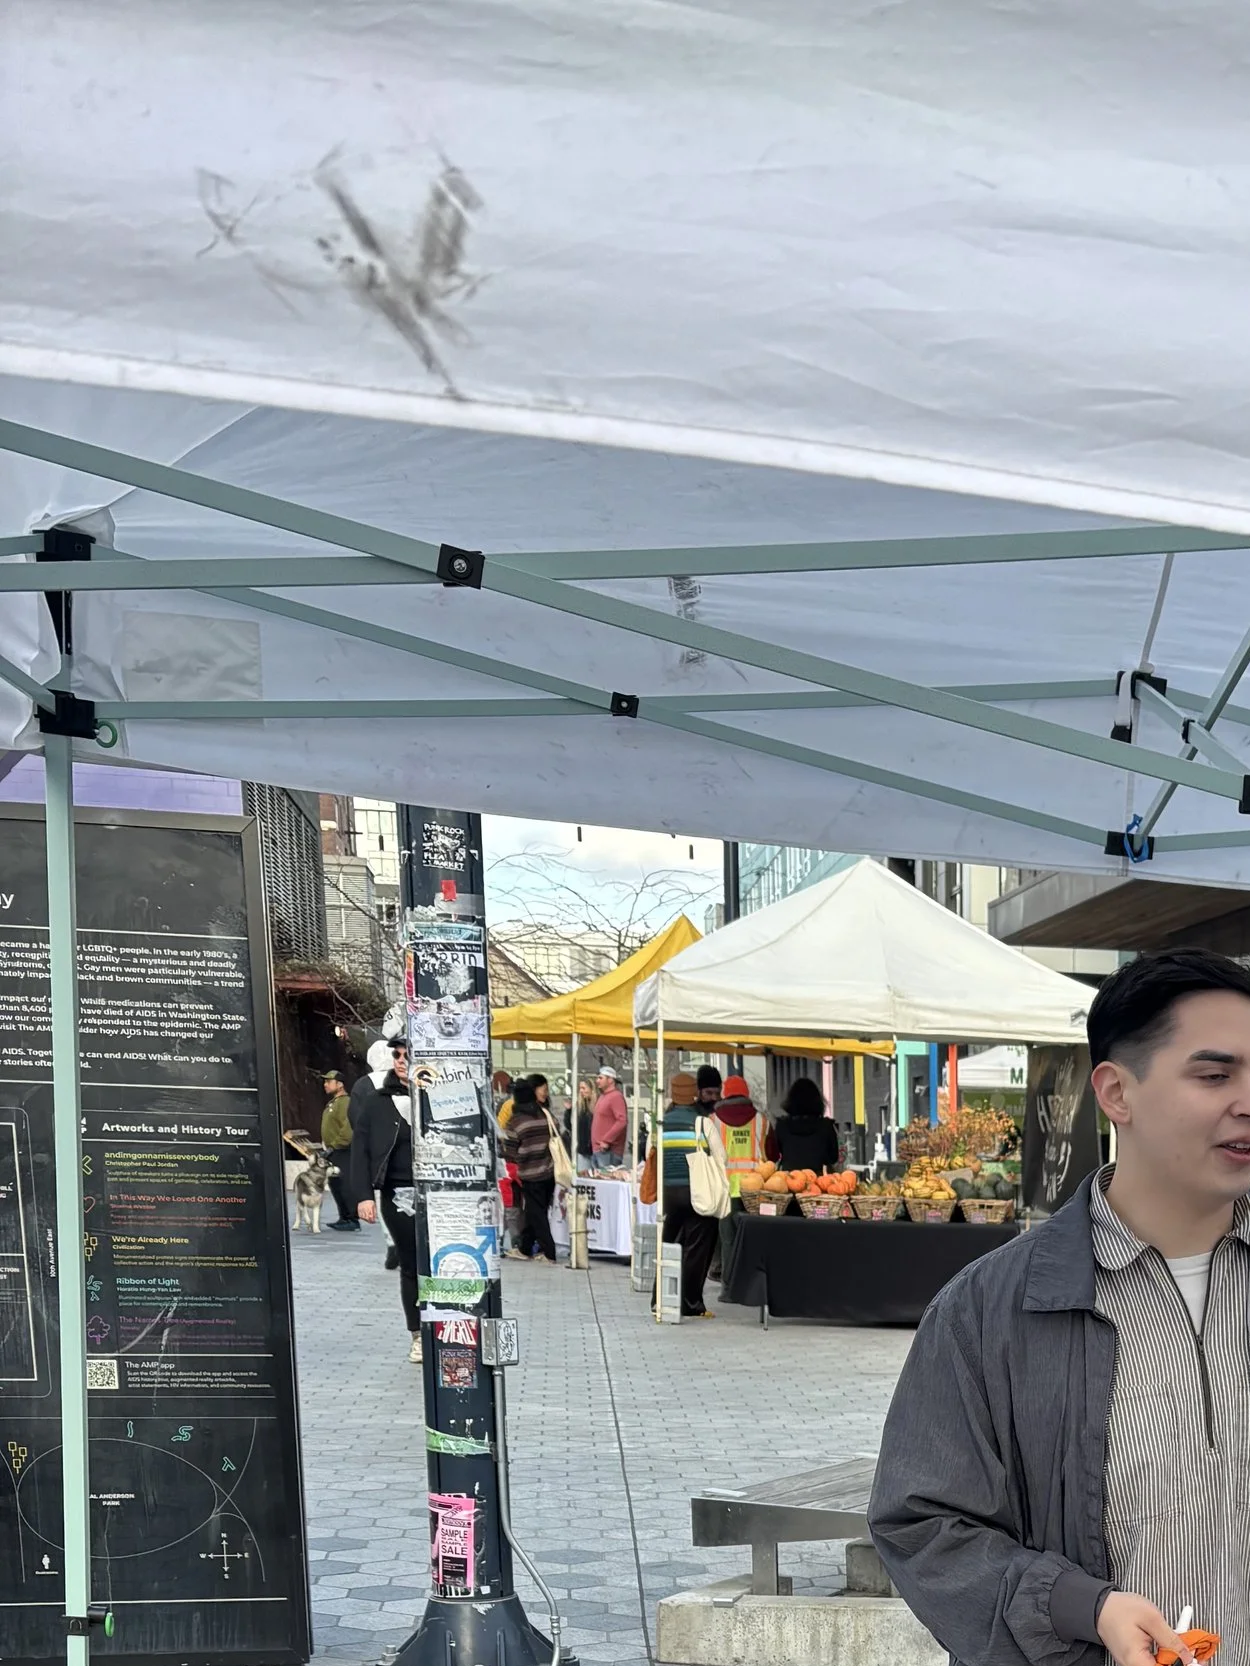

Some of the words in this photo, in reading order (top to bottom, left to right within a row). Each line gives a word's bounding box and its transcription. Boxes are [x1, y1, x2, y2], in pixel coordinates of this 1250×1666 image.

[444, 826, 464, 835] ROCK
[424, 853, 444, 861] FLEA
[433, 860, 464, 870] MARKET
[82, 944, 118, 954] LGBTQ+
[120, 947, 152, 955] people.
[163, 948, 178, 956] the
[180, 950, 200, 958] early
[202, 950, 231, 959] 1980's,
[84, 964, 100, 972] Gay
[124, 966, 146, 974] were
[148, 968, 196, 977] particularly
[198, 970, 246, 979] vulnerable,
[80, 1007, 101, 1015] have
[104, 1008, 123, 1016] died
[136, 1010, 156, 1018] AIDS
[158, 1010, 166, 1018] in
[168, 1010, 220, 1020] Washington
[222, 1013, 247, 1022] State.
[102, 1122, 154, 1133] Artworks
[158, 1124, 178, 1134] and
[182, 1125, 222, 1136] History
[224, 1126, 250, 1136] Tour
[104, 1152, 219, 1162] andimgonnamisseverybody
[105, 1160, 141, 1168] Christopher
[138, 1195, 156, 1203] Way
[112, 1235, 136, 1243] We're
[138, 1236, 168, 1244] Already
[158, 1278, 180, 1286] Light
[441, 1528, 468, 1538] SAMPLE
[441, 1544, 468, 1555] SALE
